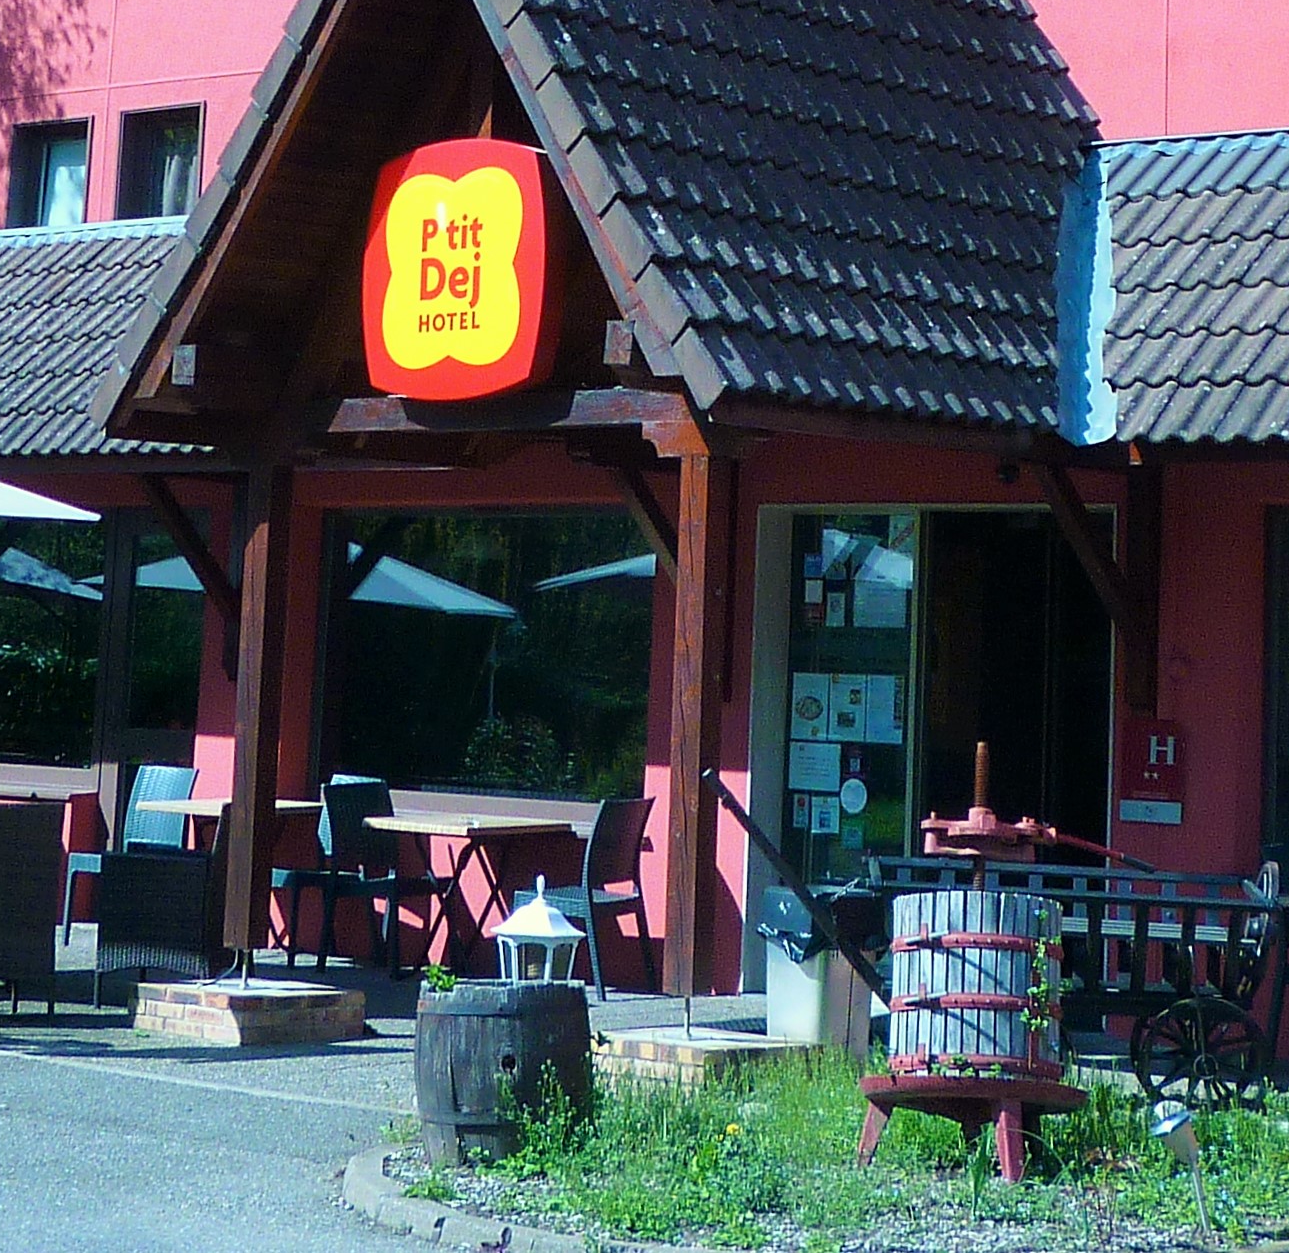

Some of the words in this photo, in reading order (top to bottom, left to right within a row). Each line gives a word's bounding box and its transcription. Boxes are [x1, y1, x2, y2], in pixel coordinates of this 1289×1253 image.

[421, 213, 483, 252] Ptit
[420, 251, 481, 309] Dej
[418, 310, 481, 333] HOTEL
[1148, 735, 1176, 766] H
